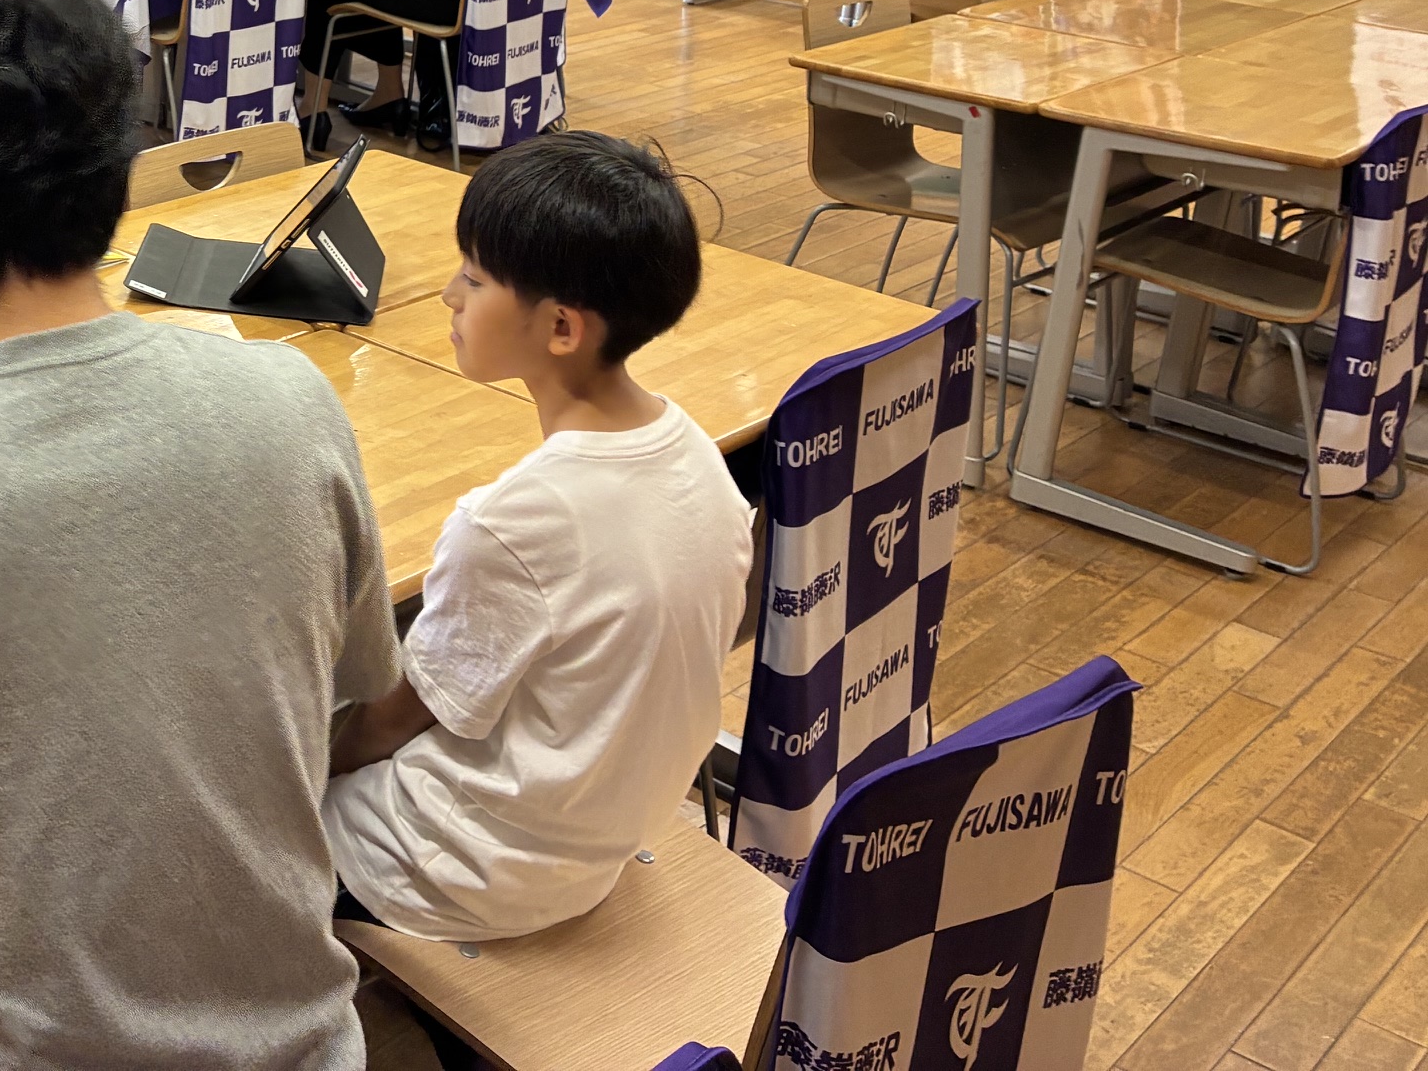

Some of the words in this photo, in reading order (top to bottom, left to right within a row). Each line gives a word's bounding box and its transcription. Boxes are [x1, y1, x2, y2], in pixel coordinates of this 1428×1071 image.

[230, 50, 272, 70] FUJISAWA
[467, 51, 500, 67] TOHREI
[862, 378, 934, 436] FUJISAWA
[775, 424, 843, 468] TOHREI
[843, 643, 910, 712] FUJISAWA
[768, 707, 830, 757] TOHREI
[955, 784, 1073, 843] FUJISAWA
[841, 818, 934, 874] TOHREI
